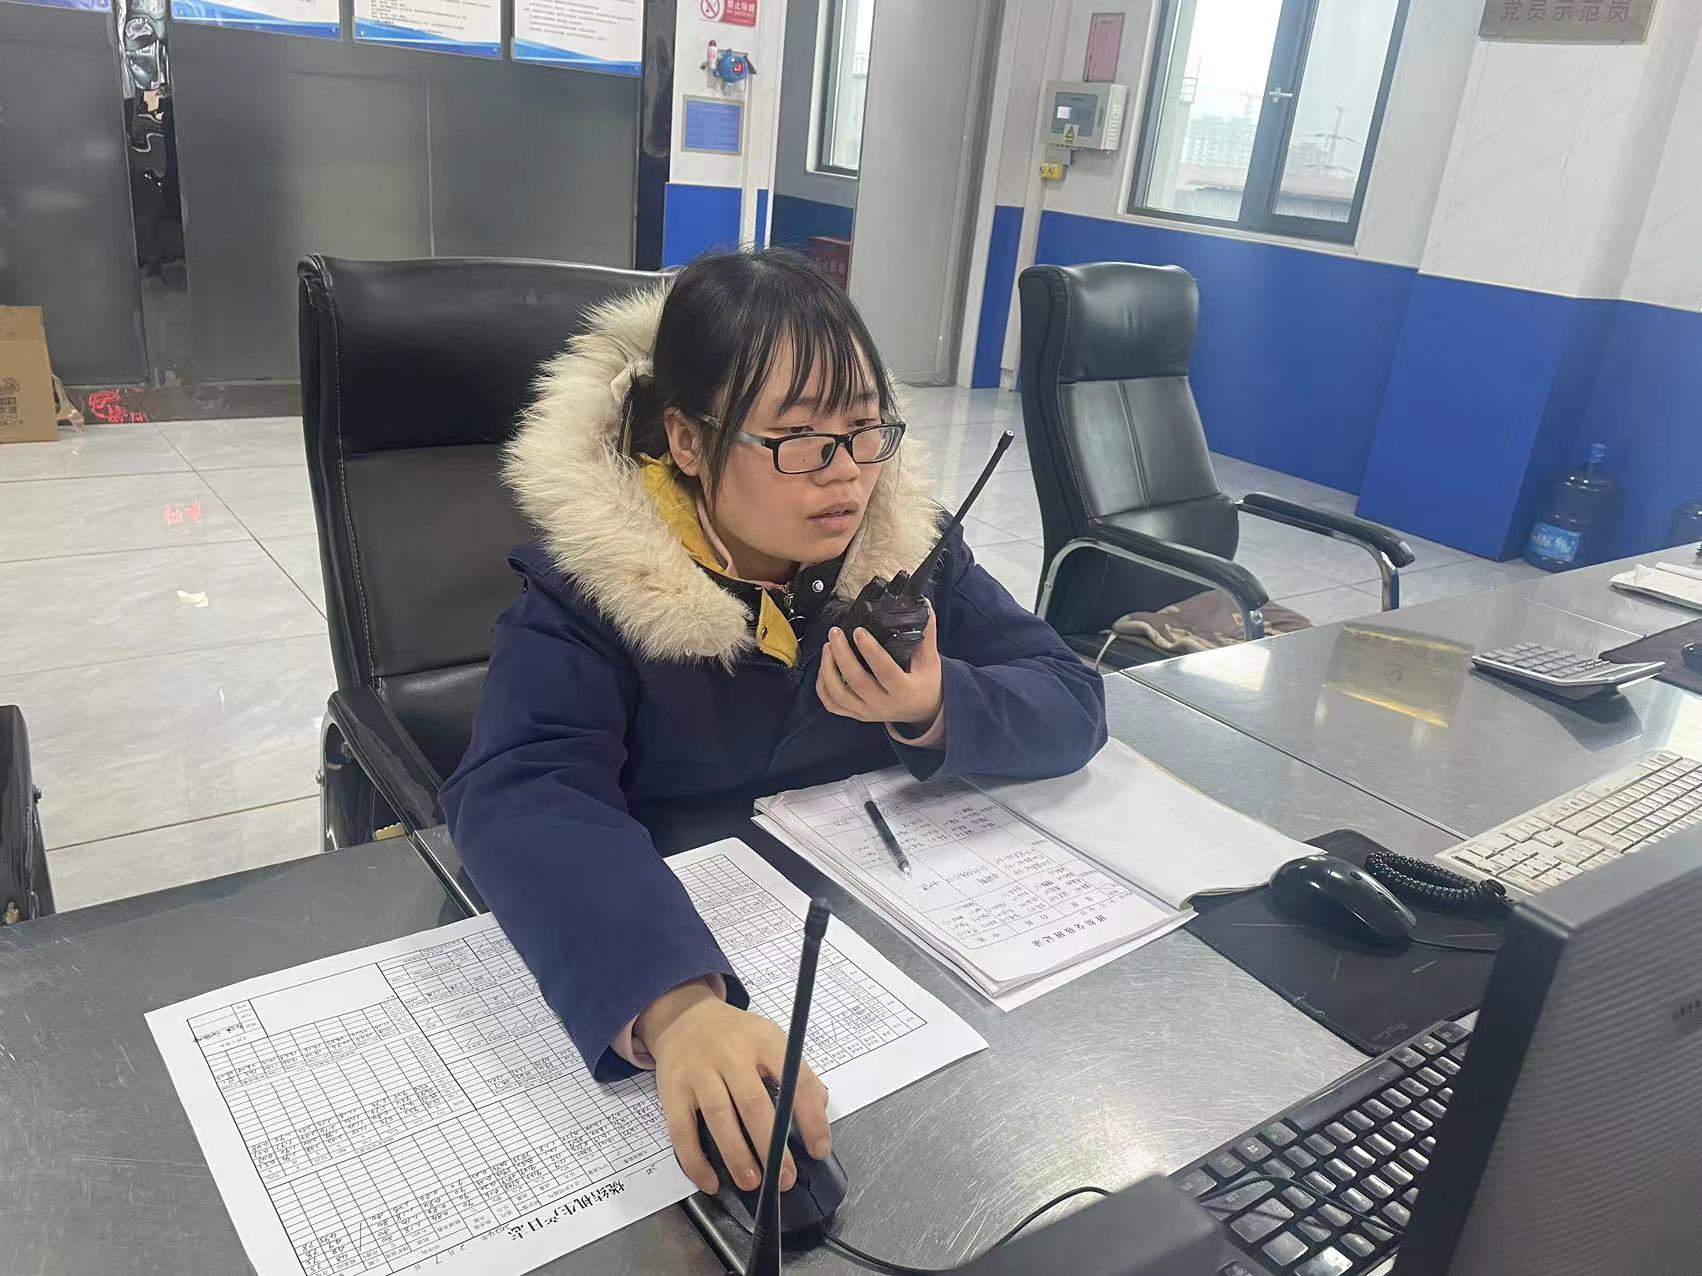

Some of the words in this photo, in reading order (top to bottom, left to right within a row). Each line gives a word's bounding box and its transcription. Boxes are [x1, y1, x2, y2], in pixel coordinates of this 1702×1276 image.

[505, 1178, 627, 1242] 烧结机生产日志
